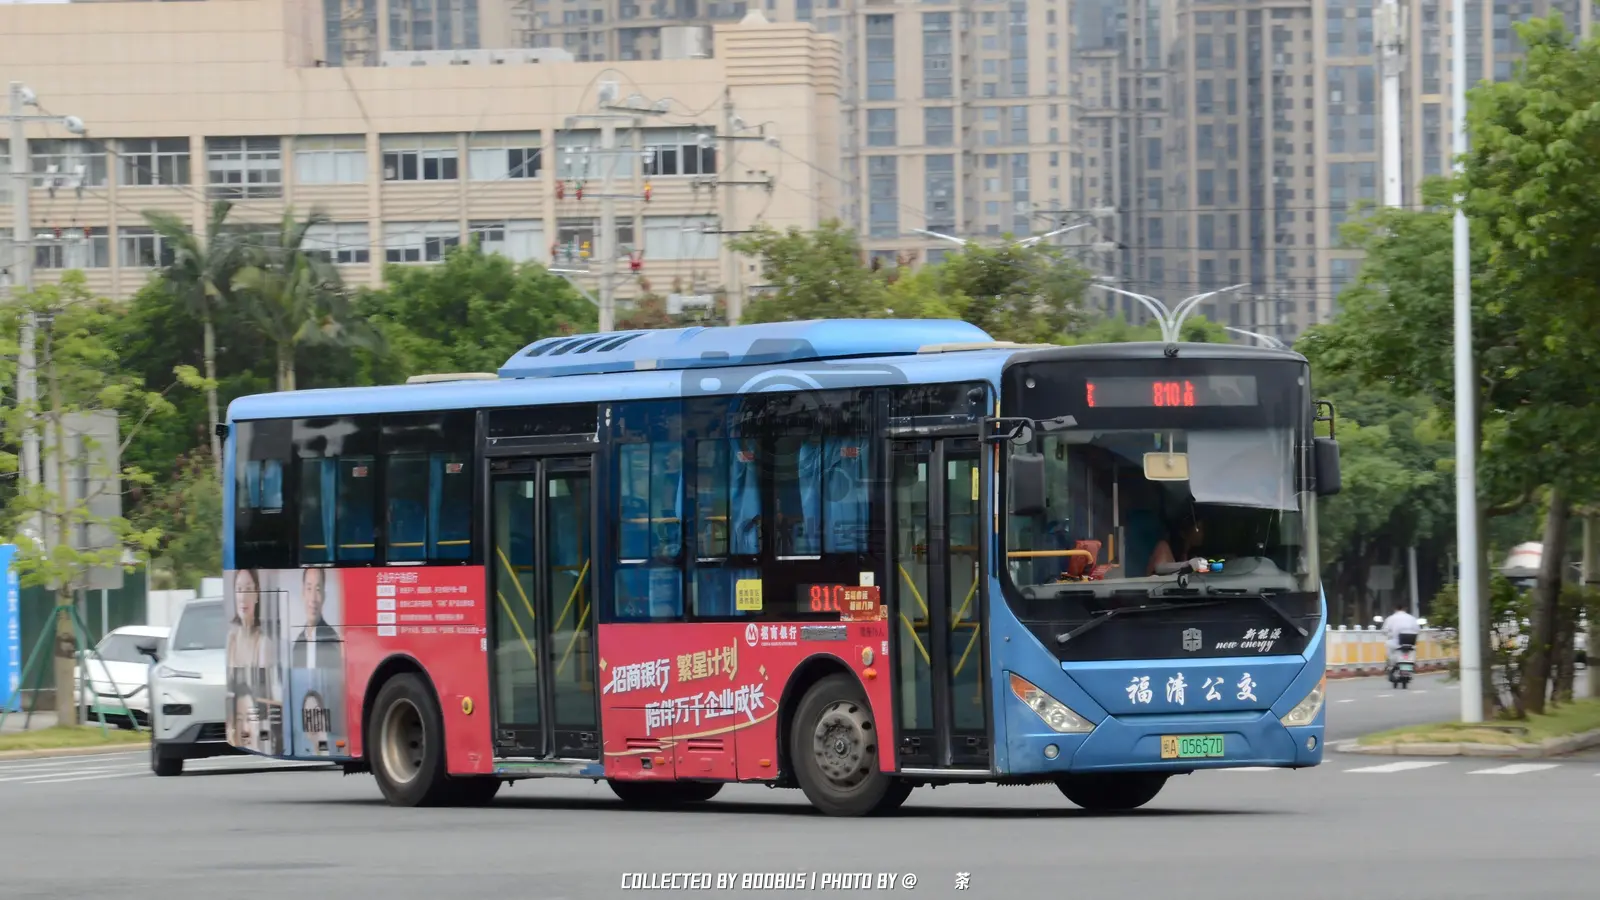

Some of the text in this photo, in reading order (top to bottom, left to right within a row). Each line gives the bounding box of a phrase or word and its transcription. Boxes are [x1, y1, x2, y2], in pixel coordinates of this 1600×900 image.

[760, 625, 797, 640] 招商银行
[1243, 628, 1282, 640] 新能源
[1215, 639, 1275, 652] new energy
[603, 637, 738, 694] 招商银行 繁星计划
[1125, 672, 1257, 706] 福清公交
[645, 683, 764, 736] 陪伴万千企业成长
